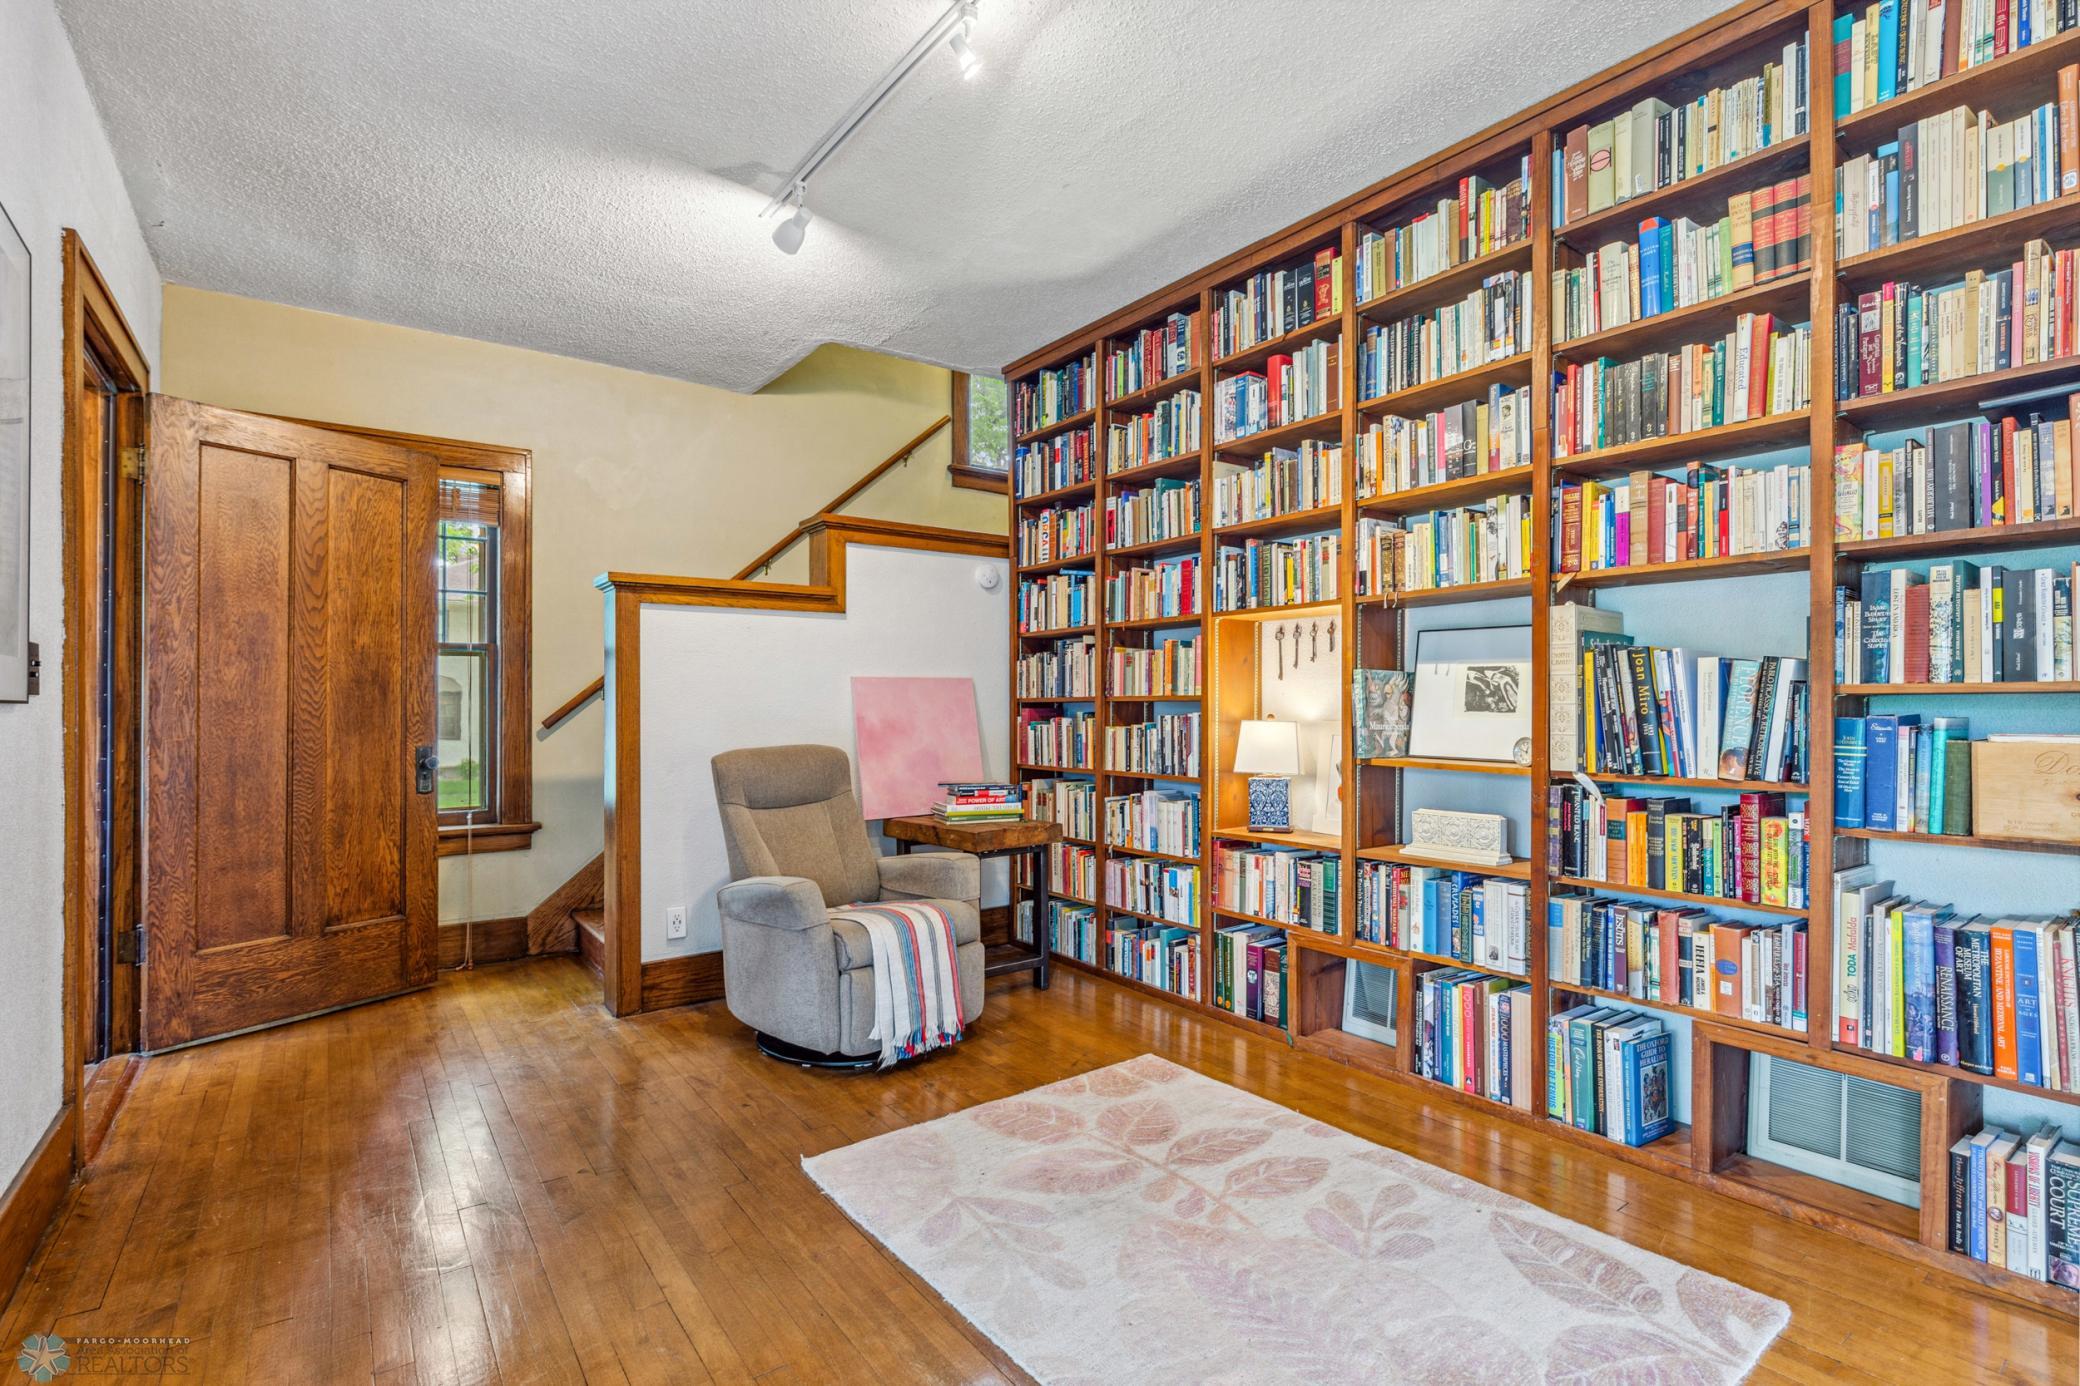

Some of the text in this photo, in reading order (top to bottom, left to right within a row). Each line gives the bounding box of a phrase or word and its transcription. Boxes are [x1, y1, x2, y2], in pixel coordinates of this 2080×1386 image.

[1737, 347, 1748, 390] Educated
[1633, 654, 1646, 680] Joan
[1767, 661, 1777, 683] PABLO
[1732, 665, 1760, 745] FLORENCE
[1754, 720, 1768, 776] RETROSPECTIVE
[1451, 883, 1459, 923] CRUSADES
[1695, 945, 1705, 974] IBERIA
[1846, 917, 1857, 977] TODA Mafalda
[1955, 946, 1964, 974] OF ART
[1962, 947, 1972, 980] MUSEUM
[1980, 950, 1989, 966] THE
[1971, 937, 1982, 997] METROPOLITAN
[1995, 948, 2003, 985] BYZANTINE
[1940, 965, 1954, 1031] RENAISSANCE
[2062, 958, 2077, 1009] KNIGHTS
[1996, 1001, 2005, 1033] MEDIEVAL
[1636, 1037, 1669, 1052] THE OXFORD
[1641, 1048, 1658, 1059] GUIDE
[1997, 1034, 2006, 1049] ART
[1639, 1055, 1667, 1066] HERALDRY
[1952, 1177, 1966, 1209] Jefferson
[2050, 1175, 2066, 1229] COURT
[2066, 1179, 2080, 1245] SUPREME
